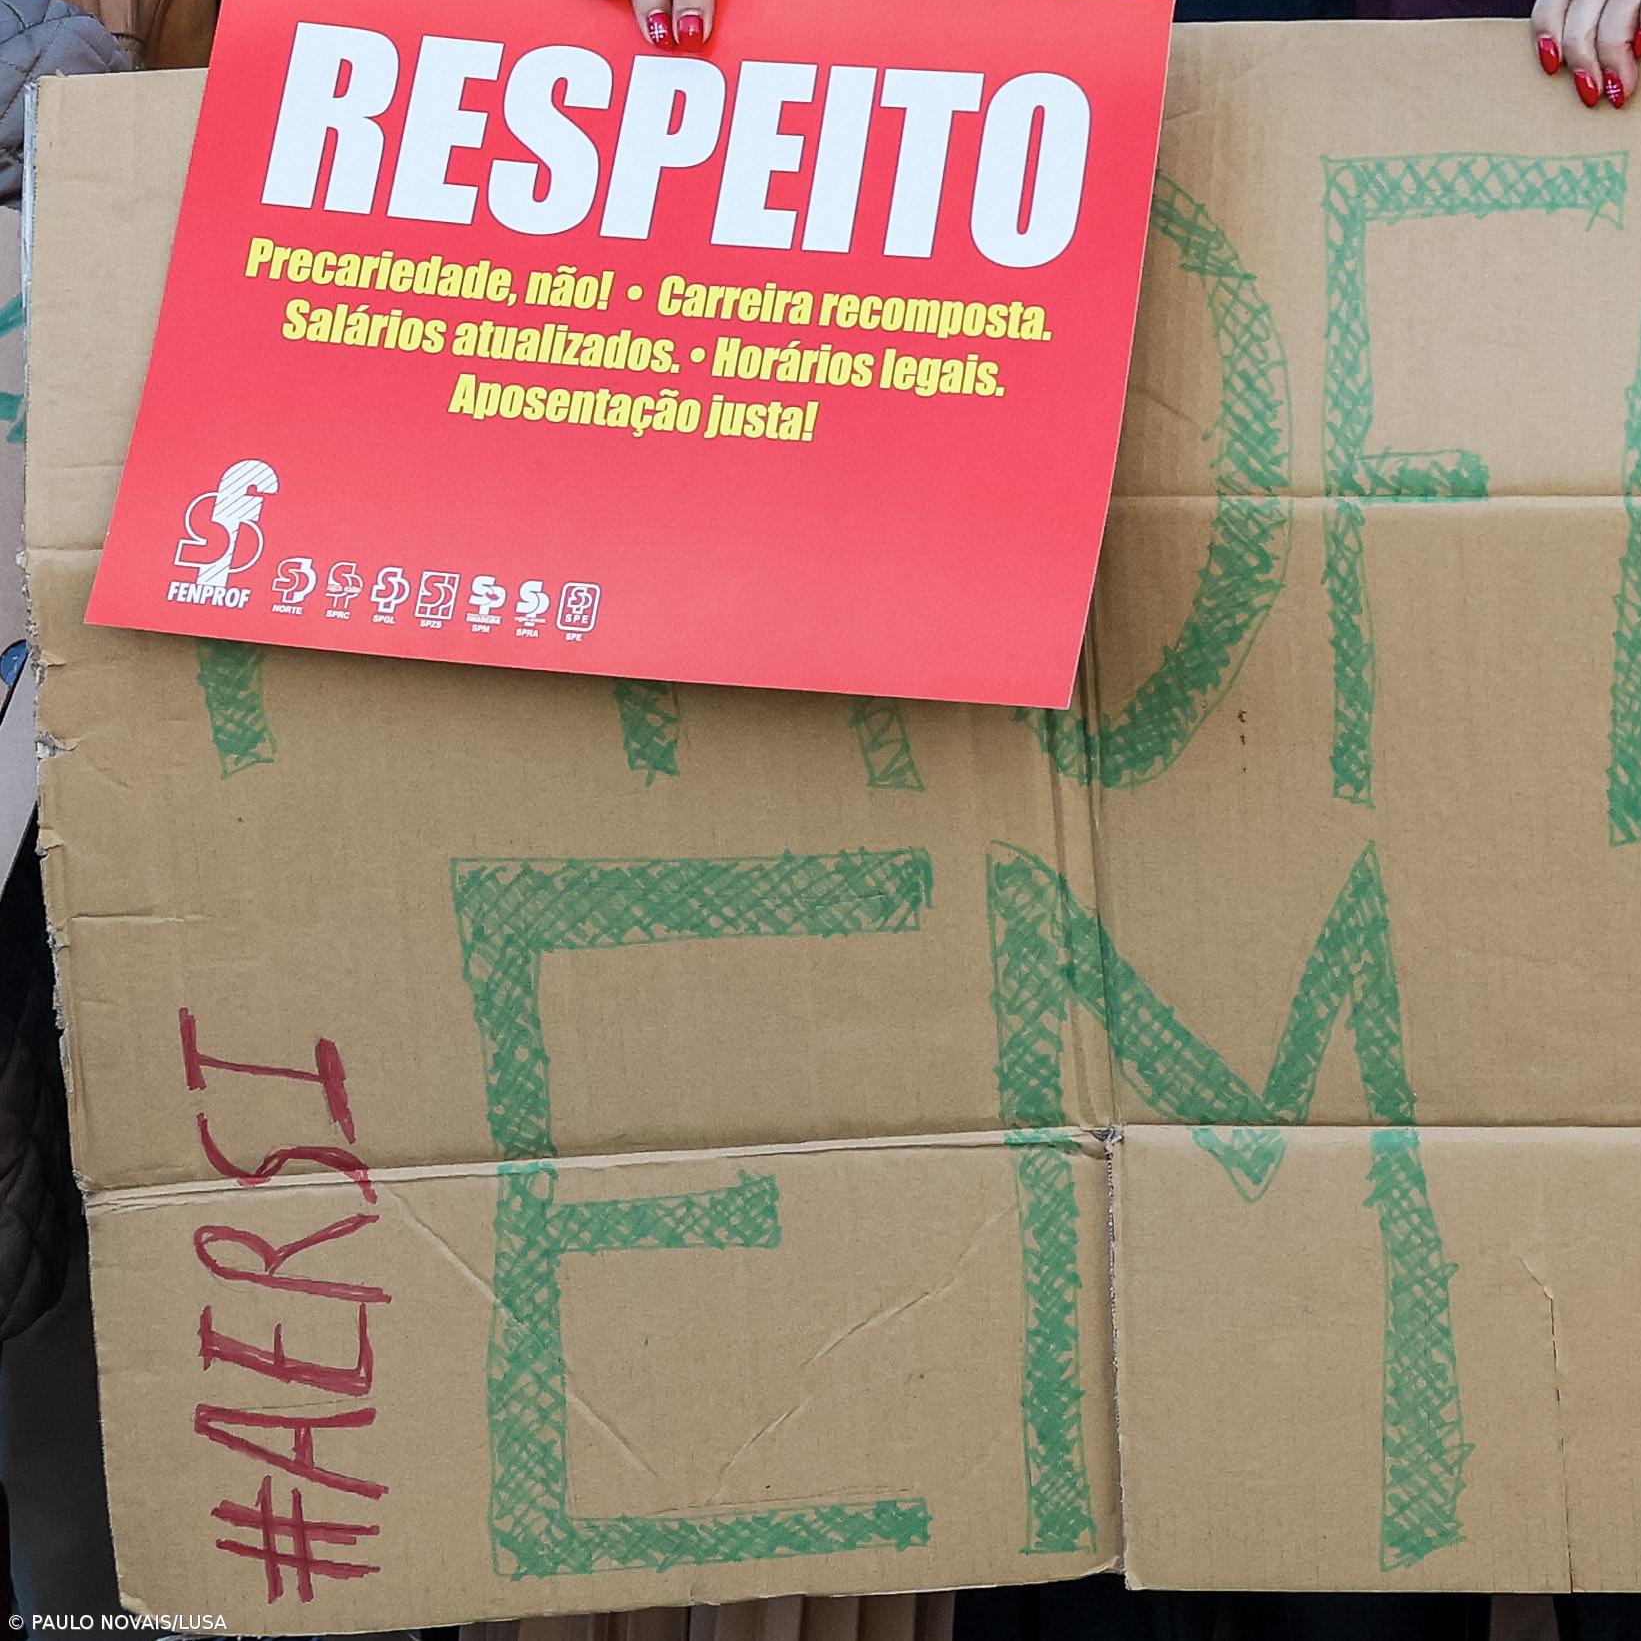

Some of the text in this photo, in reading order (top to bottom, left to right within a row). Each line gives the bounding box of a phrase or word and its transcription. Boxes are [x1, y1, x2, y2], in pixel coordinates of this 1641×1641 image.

[260, 21, 1092, 268] RESPEITO
[244, 237, 1054, 342] Precariedade, não! Carreira recomposta.
[281, 298, 1007, 399] Salários atualizados. Horários legais.
[447, 373, 820, 443] Aposentação justa!
[167, 581, 252, 609] FENPROF
[564, 613, 590, 624] SPE
[452, 840, 1478, 1580] EM
[177, 1005, 392, 1605] #AERSI
